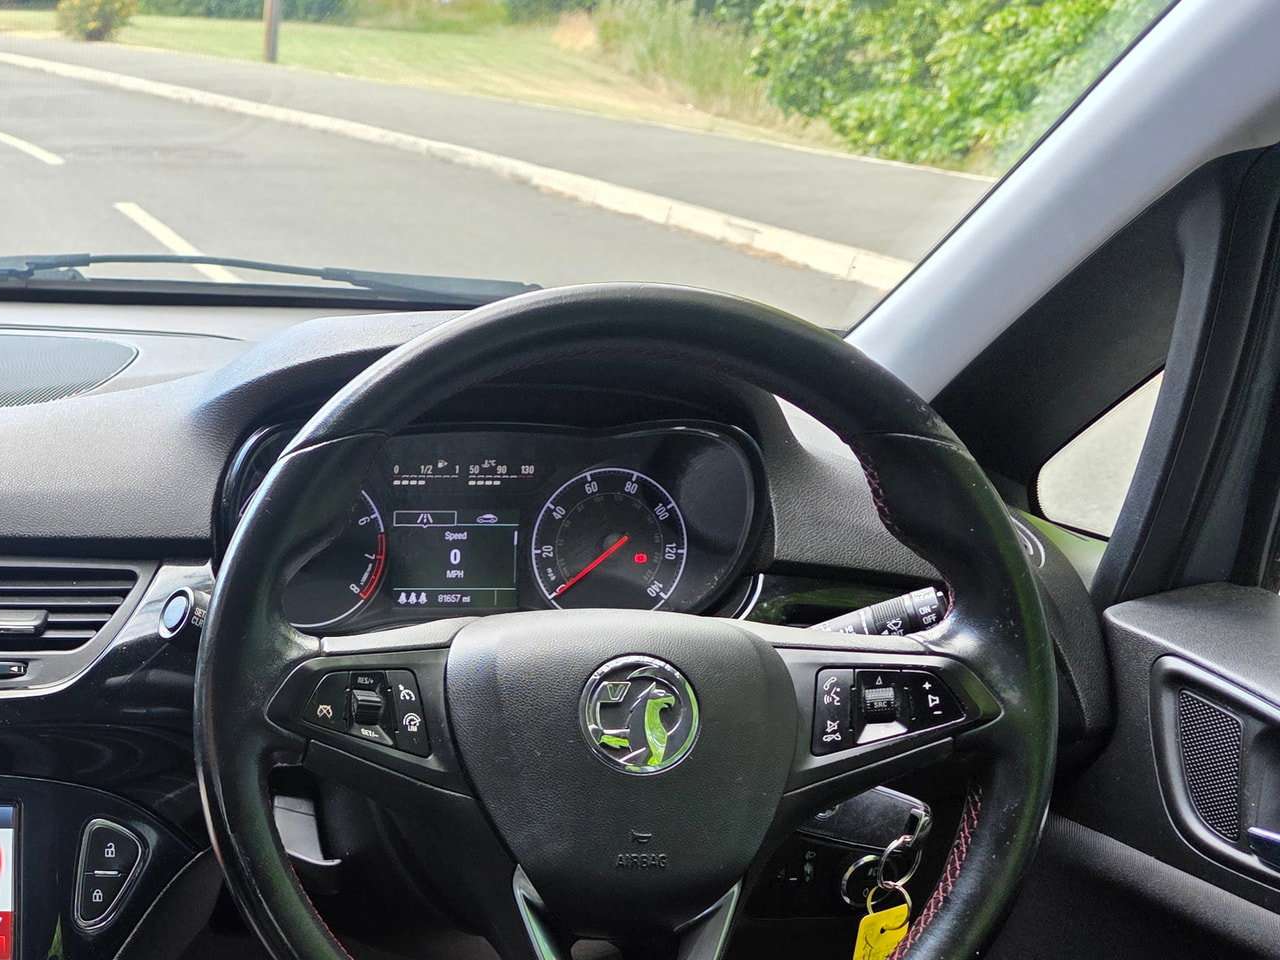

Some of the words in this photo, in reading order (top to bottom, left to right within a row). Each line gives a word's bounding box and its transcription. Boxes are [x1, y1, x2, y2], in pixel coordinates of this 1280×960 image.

[469, 465, 480, 474] 50
[496, 465, 507, 474] 90
[584, 481, 599, 495] 60
[624, 481, 638, 495] 80
[552, 505, 566, 520] 40
[653, 503, 670, 521] 100
[444, 531, 468, 542] Speed
[450, 549, 461, 565] 0
[541, 545, 554, 559] 20
[664, 543, 677, 561] 120
[446, 570, 464, 578] MPH
